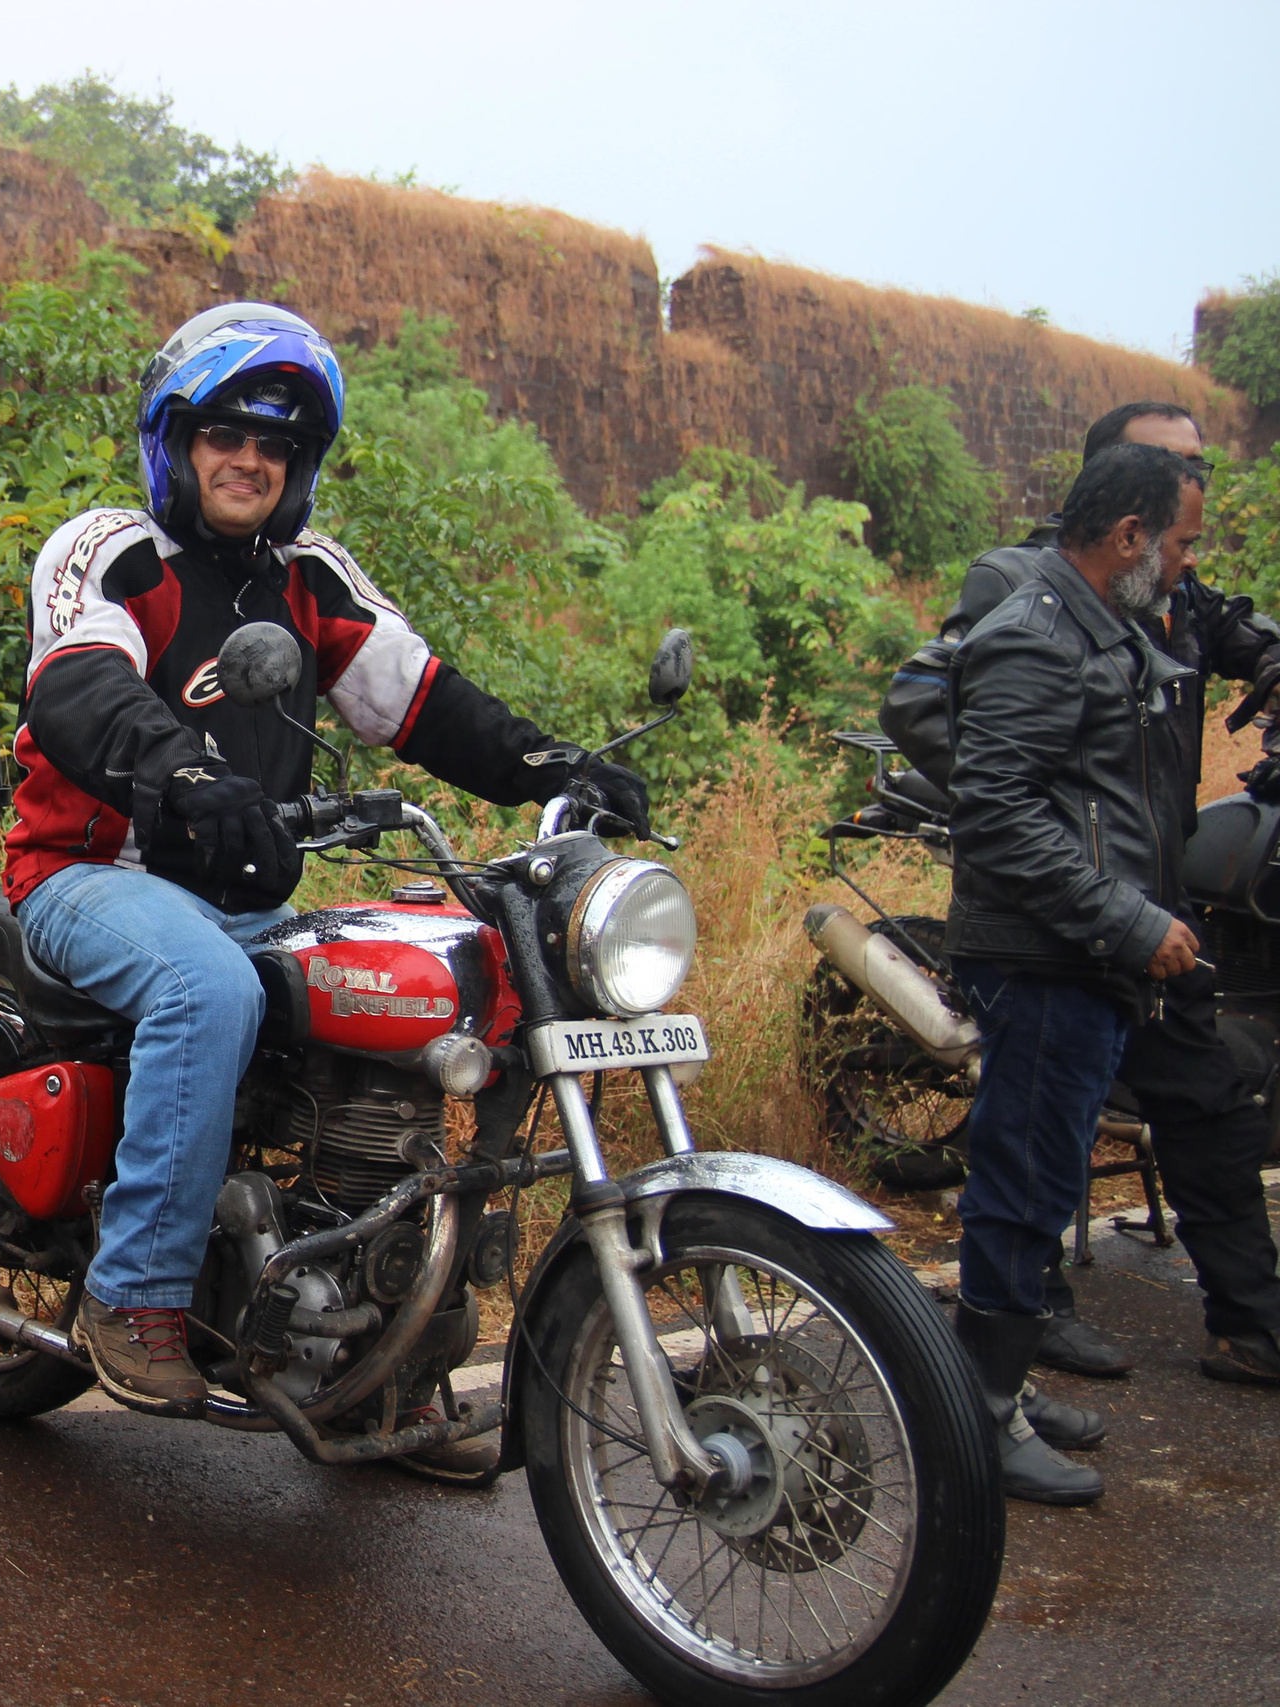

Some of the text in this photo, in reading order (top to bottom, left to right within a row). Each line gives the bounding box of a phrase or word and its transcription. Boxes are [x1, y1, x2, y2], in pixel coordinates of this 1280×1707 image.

[46, 512, 137, 636] alpinesta
[306, 956, 398, 994] ROYAL
[330, 987, 454, 1019] ENFIELD
[564, 1026, 698, 1060] MH.43.K.303
